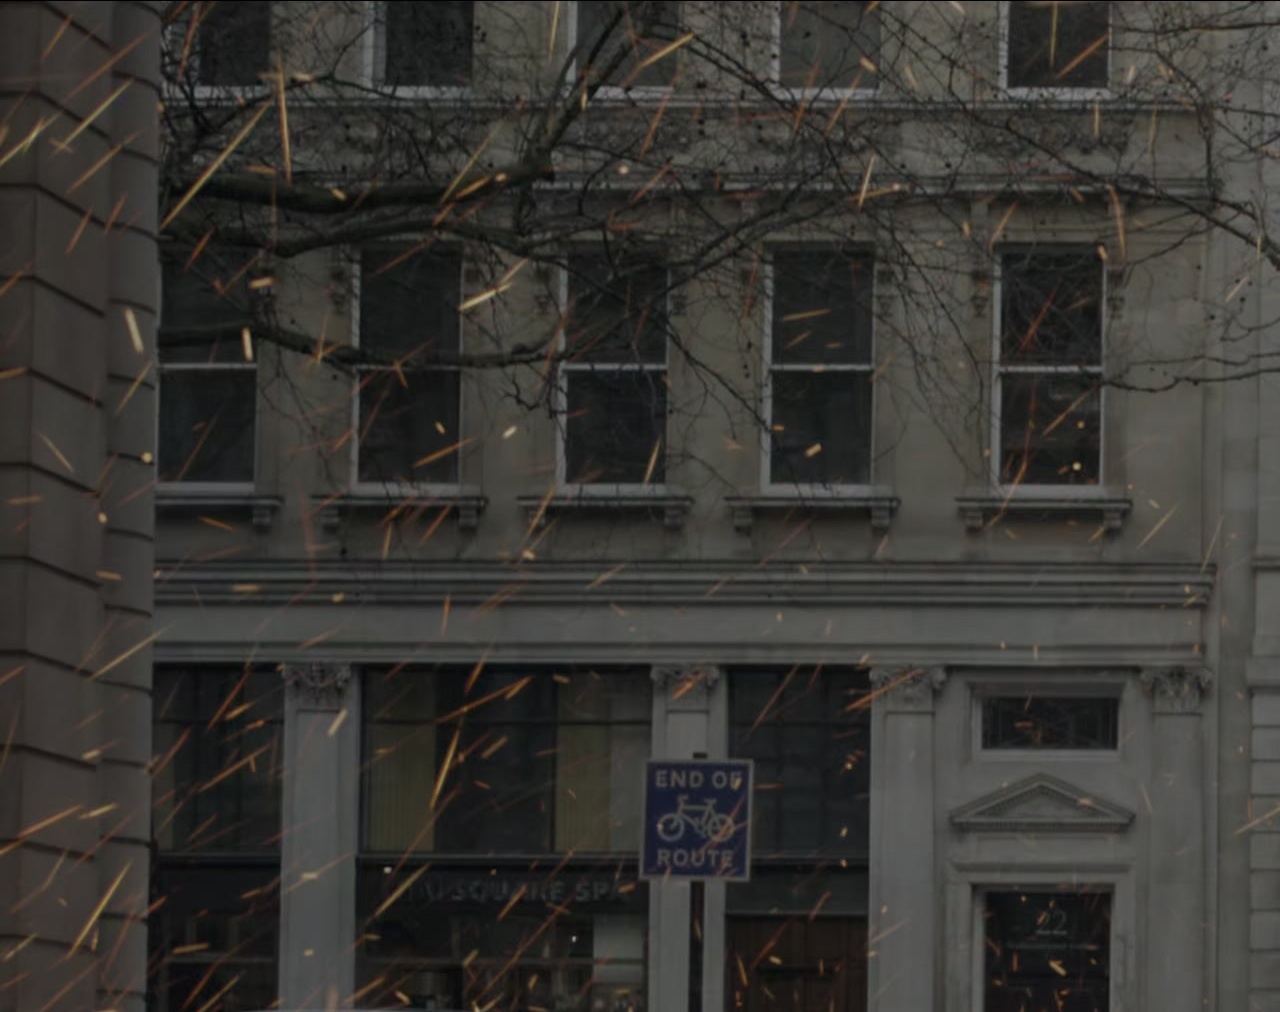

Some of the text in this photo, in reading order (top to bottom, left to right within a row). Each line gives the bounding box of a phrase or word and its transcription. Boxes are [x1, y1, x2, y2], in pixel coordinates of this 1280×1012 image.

[655, 770, 743, 789] END OF
[656, 848, 733, 868] ROUTE
[1035, 909, 1068, 935] 22
